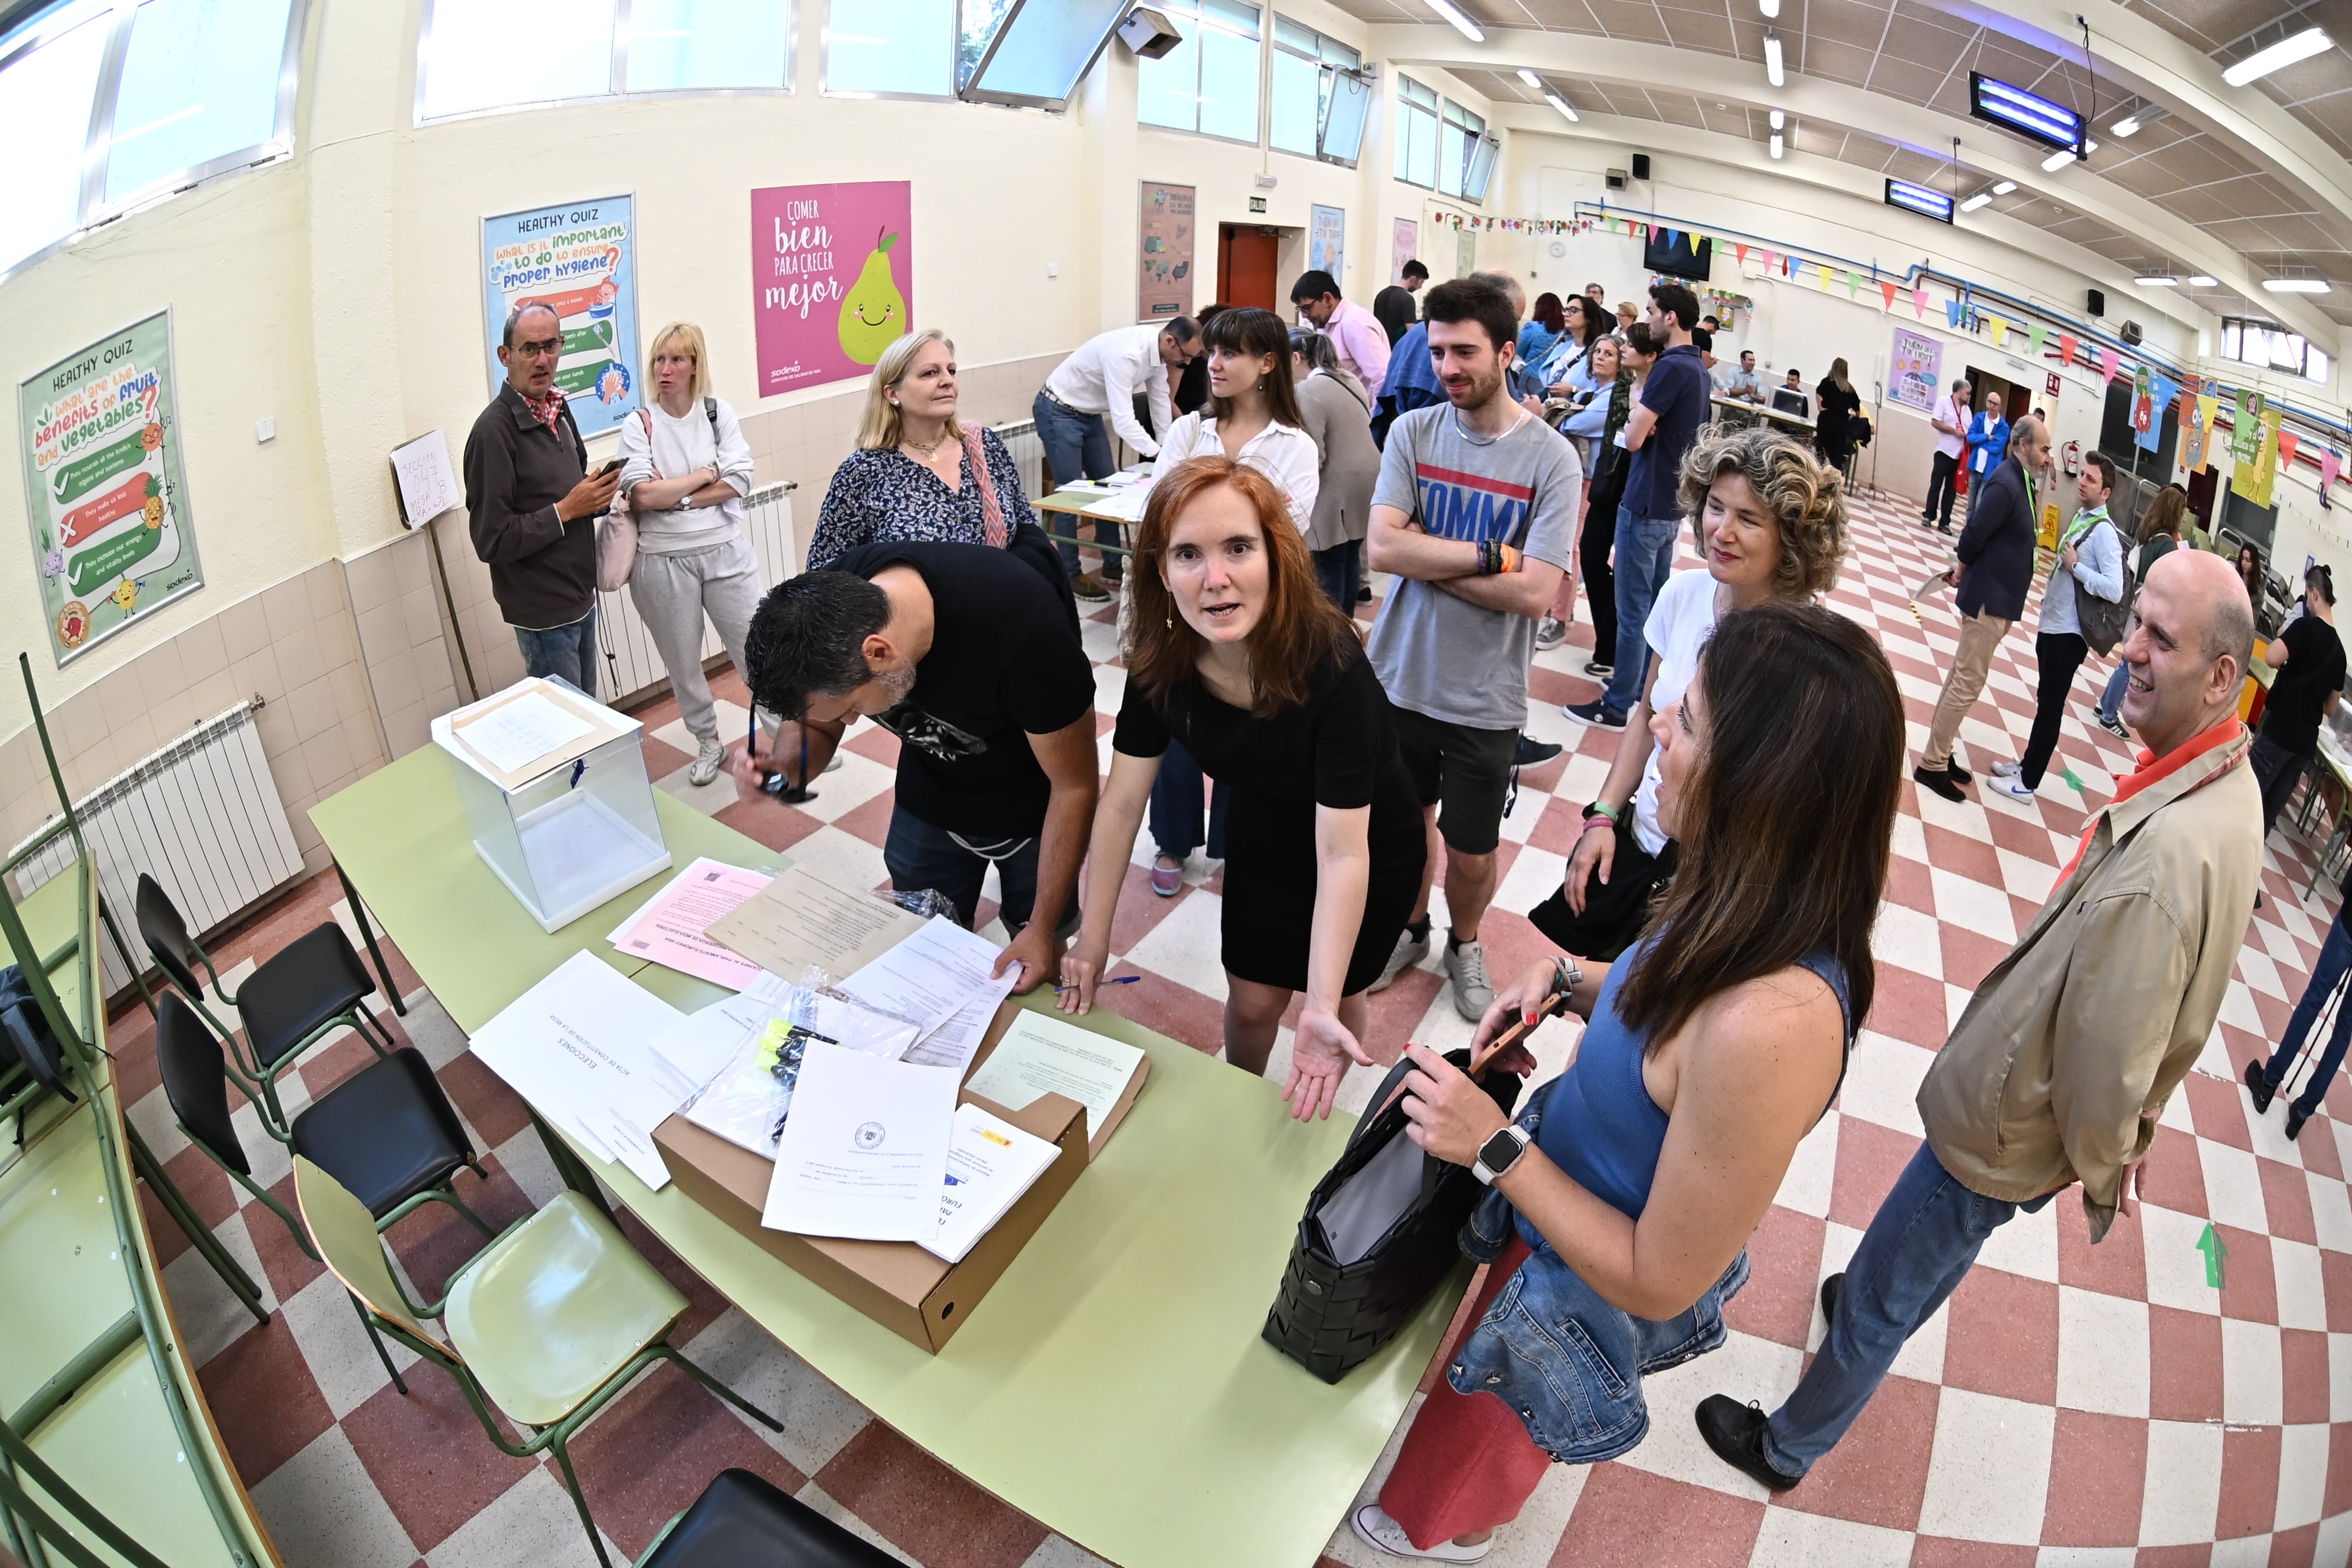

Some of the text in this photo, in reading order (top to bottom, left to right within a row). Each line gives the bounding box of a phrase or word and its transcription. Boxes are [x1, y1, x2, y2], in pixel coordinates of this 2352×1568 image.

[788, 200, 819, 221] COMER
[1250, 198, 1266, 211] SALIDA
[518, 208, 599, 234] HEALTHY QUIZ
[496, 225, 624, 260] What is it important
[775, 217, 833, 254] bien
[514, 244, 609, 269] to do to ensure
[775, 251, 834, 276] PARA CRECER
[504, 267, 550, 288] proper
[766, 274, 844, 319] mejor
[1904, 338, 1923, 350] TURN
[53, 339, 133, 392] HEALTHY QUIZ
[771, 360, 801, 377] sodexo
[56, 368, 132, 417] What are the
[36, 372, 158, 448] benefits of fruit
[38, 445, 58, 466] and
[414, 466, 439, 493] 047
[85, 508, 97, 518] They
[97, 501, 109, 510] make
[117, 492, 126, 500] less
[99, 509, 116, 522] healthy
[85, 559, 96, 569] They
[97, 550, 115, 563] increase
[126, 534, 142, 548] energy
[96, 566, 105, 576] and
[123, 550, 135, 561] levels
[166, 569, 193, 591] sodexo
[675, 941, 698, 952] EUROPEO
[699, 949, 732, 962] PARLAMENTO
[550, 1014, 563, 1026] MESA
[557, 1037, 597, 1069] ELECCIONES
[608, 1059, 617, 1067] DE
[616, 1064, 631, 1076] ACTA
